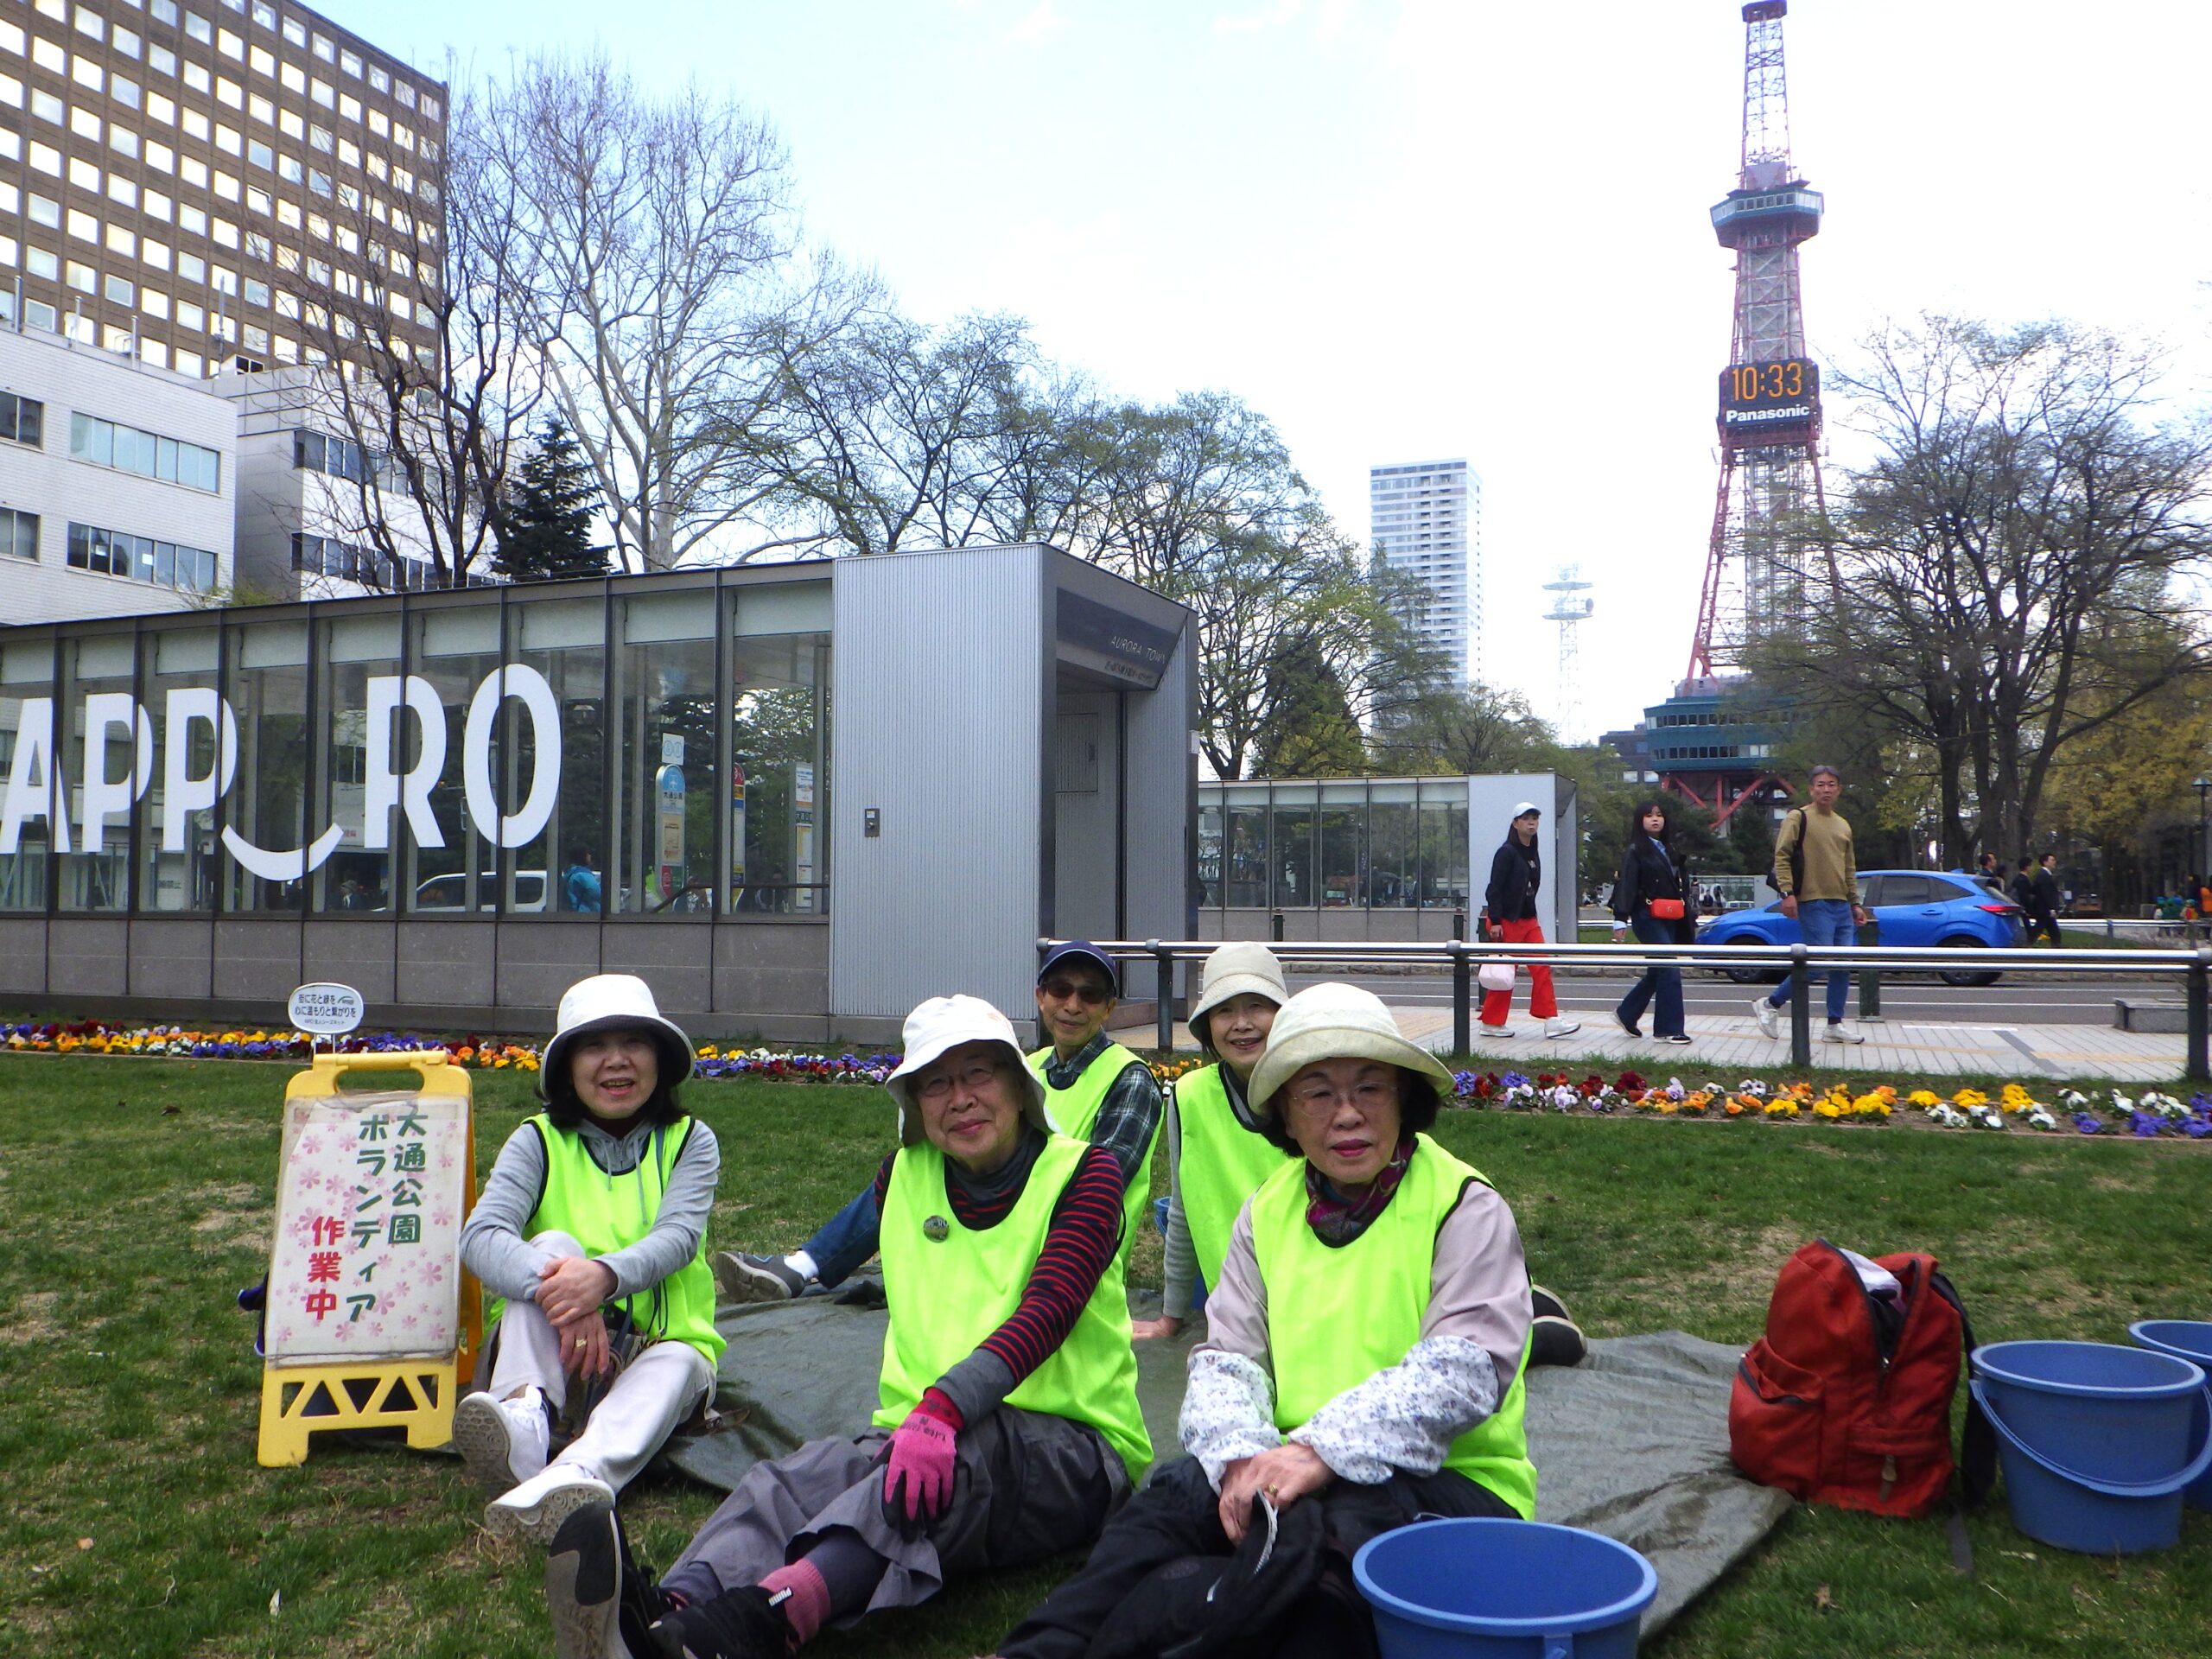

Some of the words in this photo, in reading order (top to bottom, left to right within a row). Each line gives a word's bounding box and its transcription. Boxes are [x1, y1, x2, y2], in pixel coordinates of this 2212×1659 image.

[1726, 404, 1810, 423] Panasonic
[1732, 362, 1802, 401] 10:33
[1110, 635, 1142, 656] AURORA
[389, 1109, 429, 1245] 大通公園
[345, 1113, 390, 1324] ボランティア
[305, 1215, 346, 1322] 作業中
